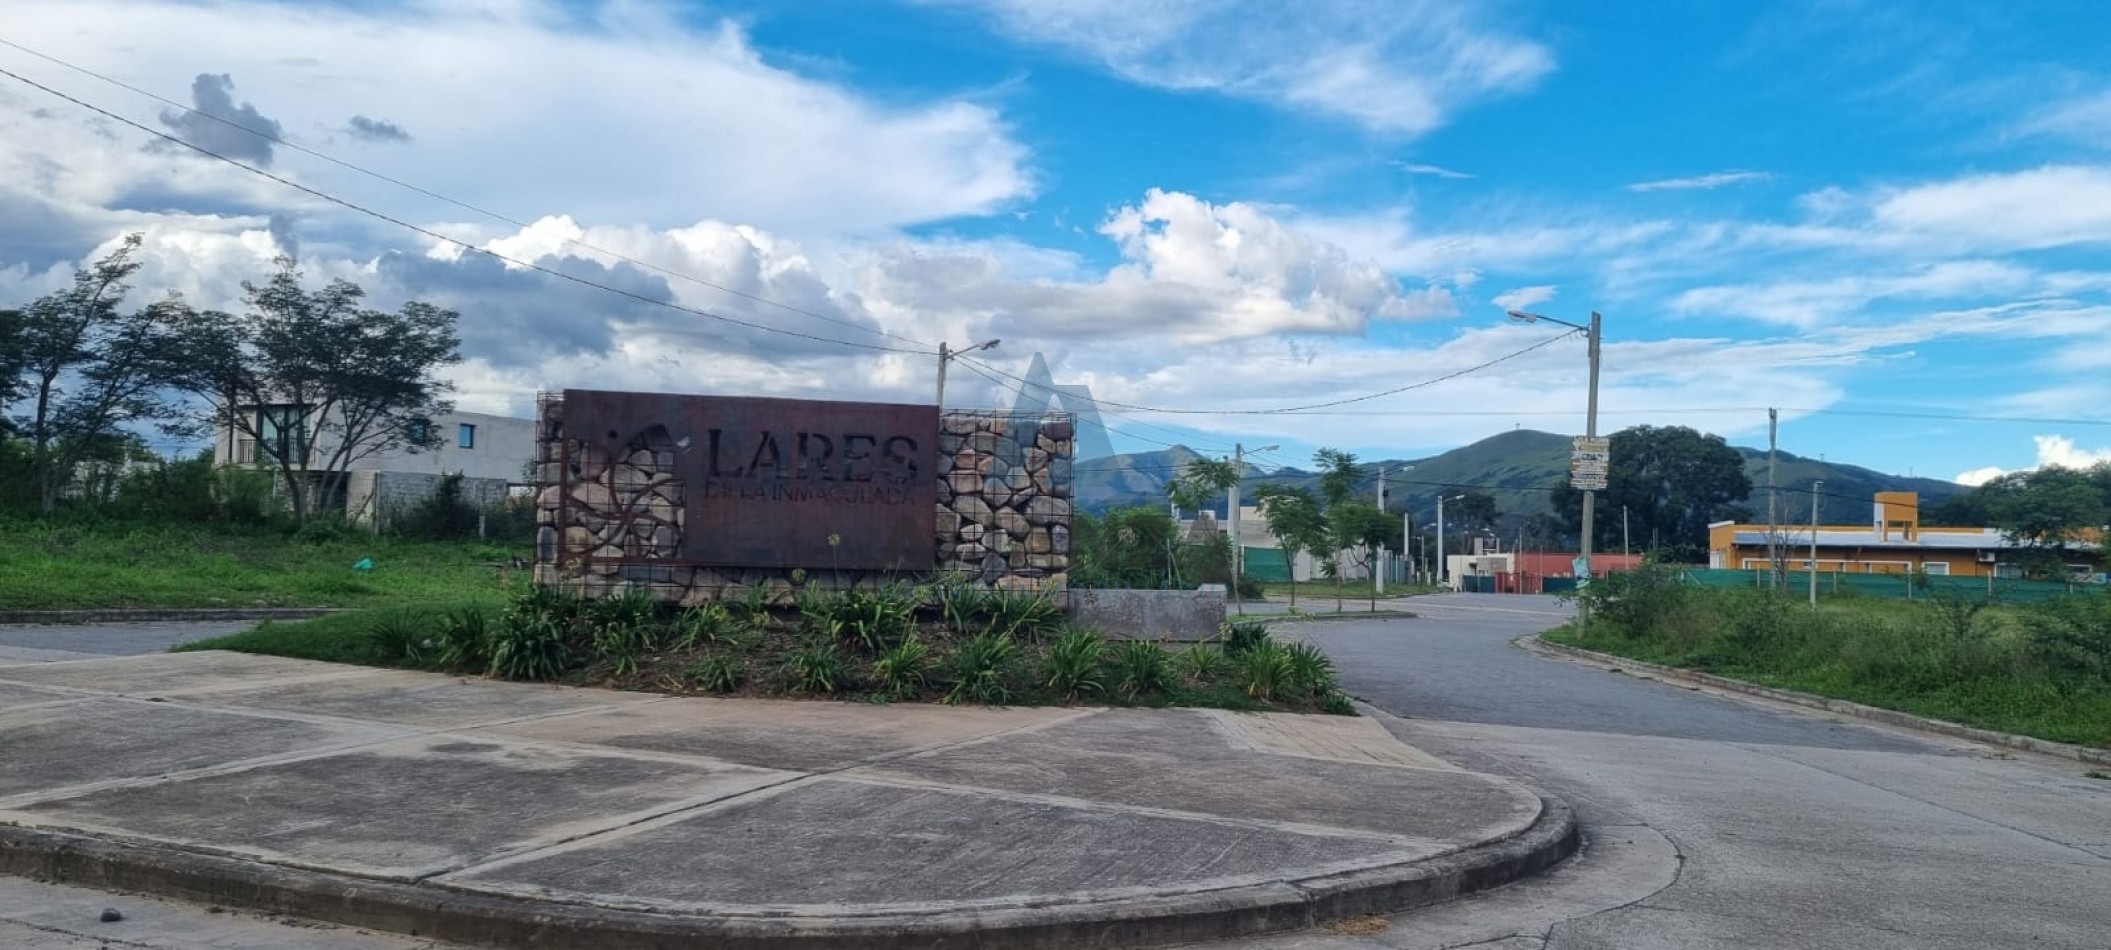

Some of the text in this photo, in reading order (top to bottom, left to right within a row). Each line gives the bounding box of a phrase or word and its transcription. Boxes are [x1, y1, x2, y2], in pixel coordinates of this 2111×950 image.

[708, 428, 918, 484] LARES
[740, 482, 767, 500] LA
[772, 482, 917, 505] INMACULADA
